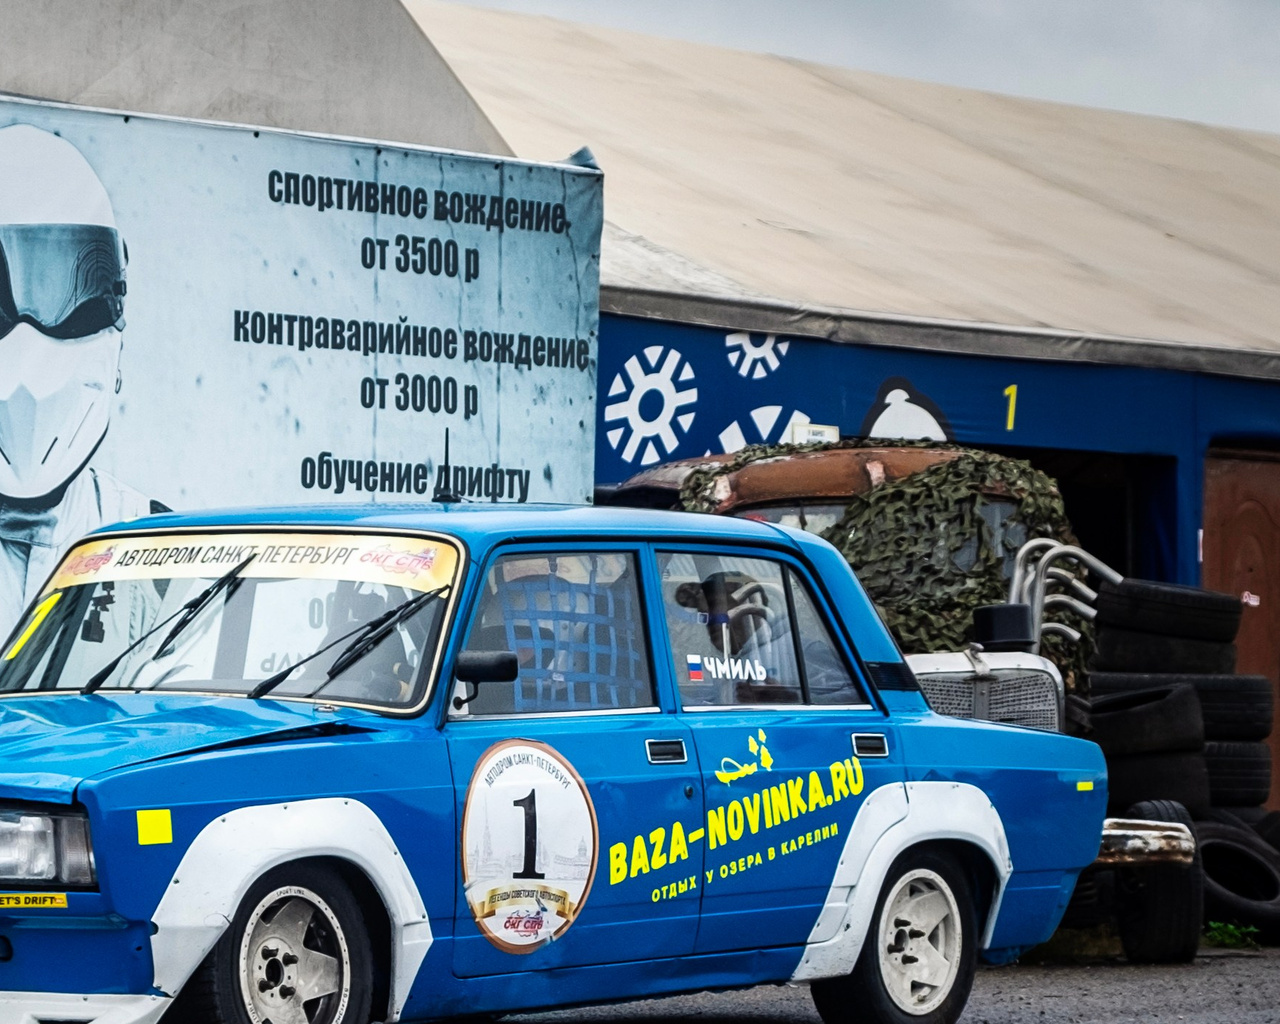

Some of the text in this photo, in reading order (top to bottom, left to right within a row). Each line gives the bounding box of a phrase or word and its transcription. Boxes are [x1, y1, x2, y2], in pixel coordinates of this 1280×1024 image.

[268, 170, 427, 219] спортивное
[361, 234, 480, 282] от 3500 р
[233, 310, 457, 359] контраварийное
[360, 373, 479, 420] от 3000 р
[1003, 384, 1018, 430] 1
[301, 452, 531, 503] обучение дрифту
[114, 546, 205, 568] АВТОДРОМ
[704, 656, 767, 681] ЧМИЛЬ
[512, 788, 545, 879] 1
[609, 756, 864, 885] BAZA-NOVINKA.RU
[651, 876, 697, 902] ОТДЫХ
[720, 853, 763, 878] ОЗЕРА
[781, 823, 839, 855] КАРЕЛИИ
[24, 896, 55, 905] DRIFT
